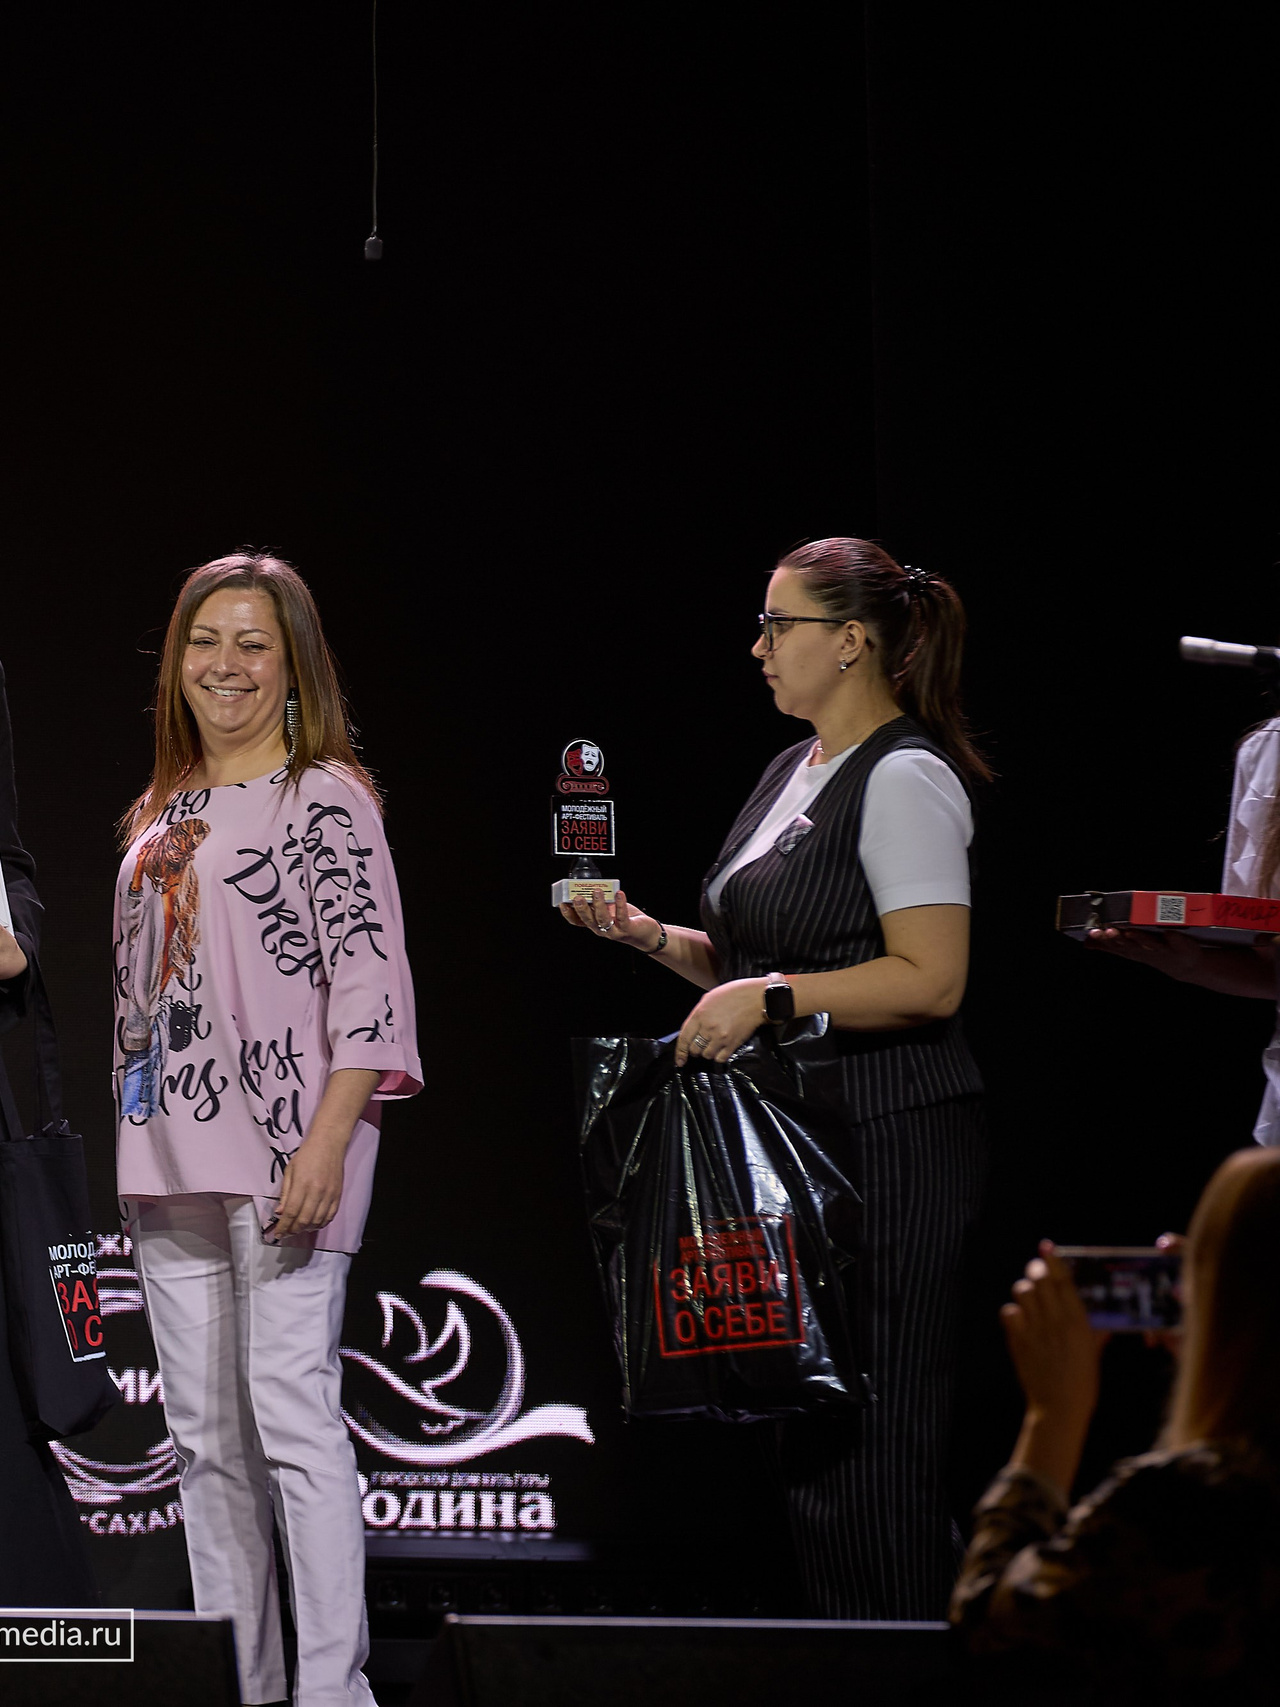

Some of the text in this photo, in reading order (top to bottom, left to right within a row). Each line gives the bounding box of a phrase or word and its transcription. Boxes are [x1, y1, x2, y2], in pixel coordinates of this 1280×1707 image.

[561, 820, 607, 835] ЗАЯВИ
[561, 836, 608, 850] О СЕБЕ
[670, 1259, 783, 1302] ЗАЯВИ
[675, 1301, 788, 1343] О СЕБЕ
[358, 1474, 556, 1530] одина
